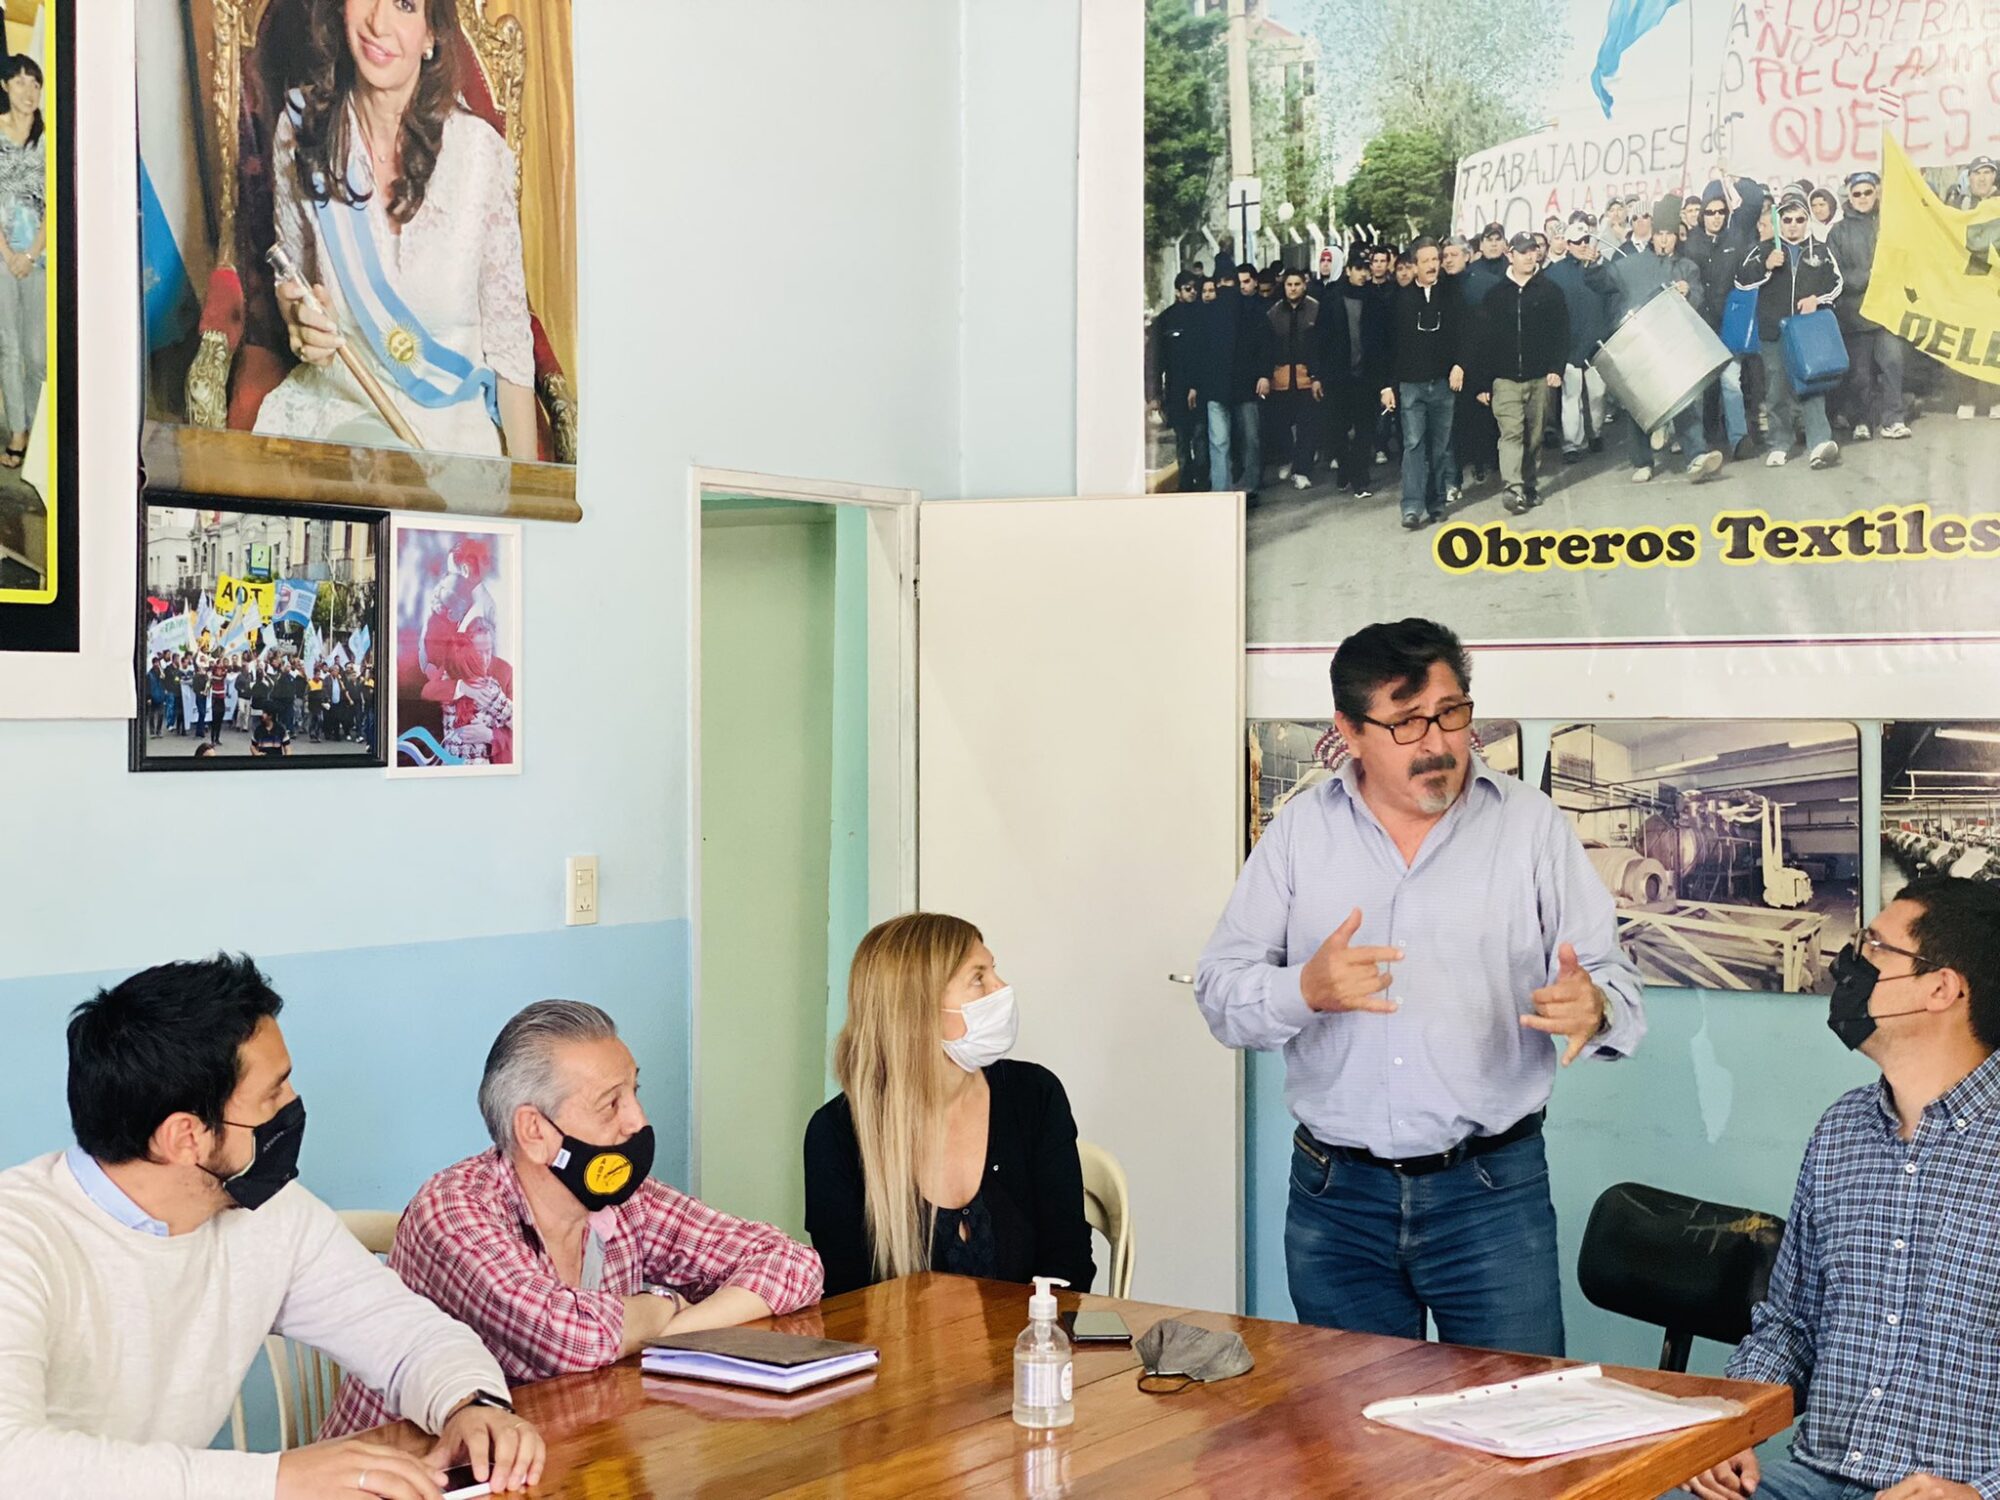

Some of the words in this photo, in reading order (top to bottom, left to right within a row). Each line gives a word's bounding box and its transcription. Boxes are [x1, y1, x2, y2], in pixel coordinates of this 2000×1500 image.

[1769, 97, 1878, 166] QUE
[1901, 86, 1971, 157] ES
[1462, 124, 1687, 200] TRABAJADORES
[1545, 188, 1561, 213] A
[1571, 186, 1595, 210] LA
[1437, 526, 1695, 568] Obreros
[1716, 510, 2000, 559] Textiles
[221, 581, 263, 605] AOT
